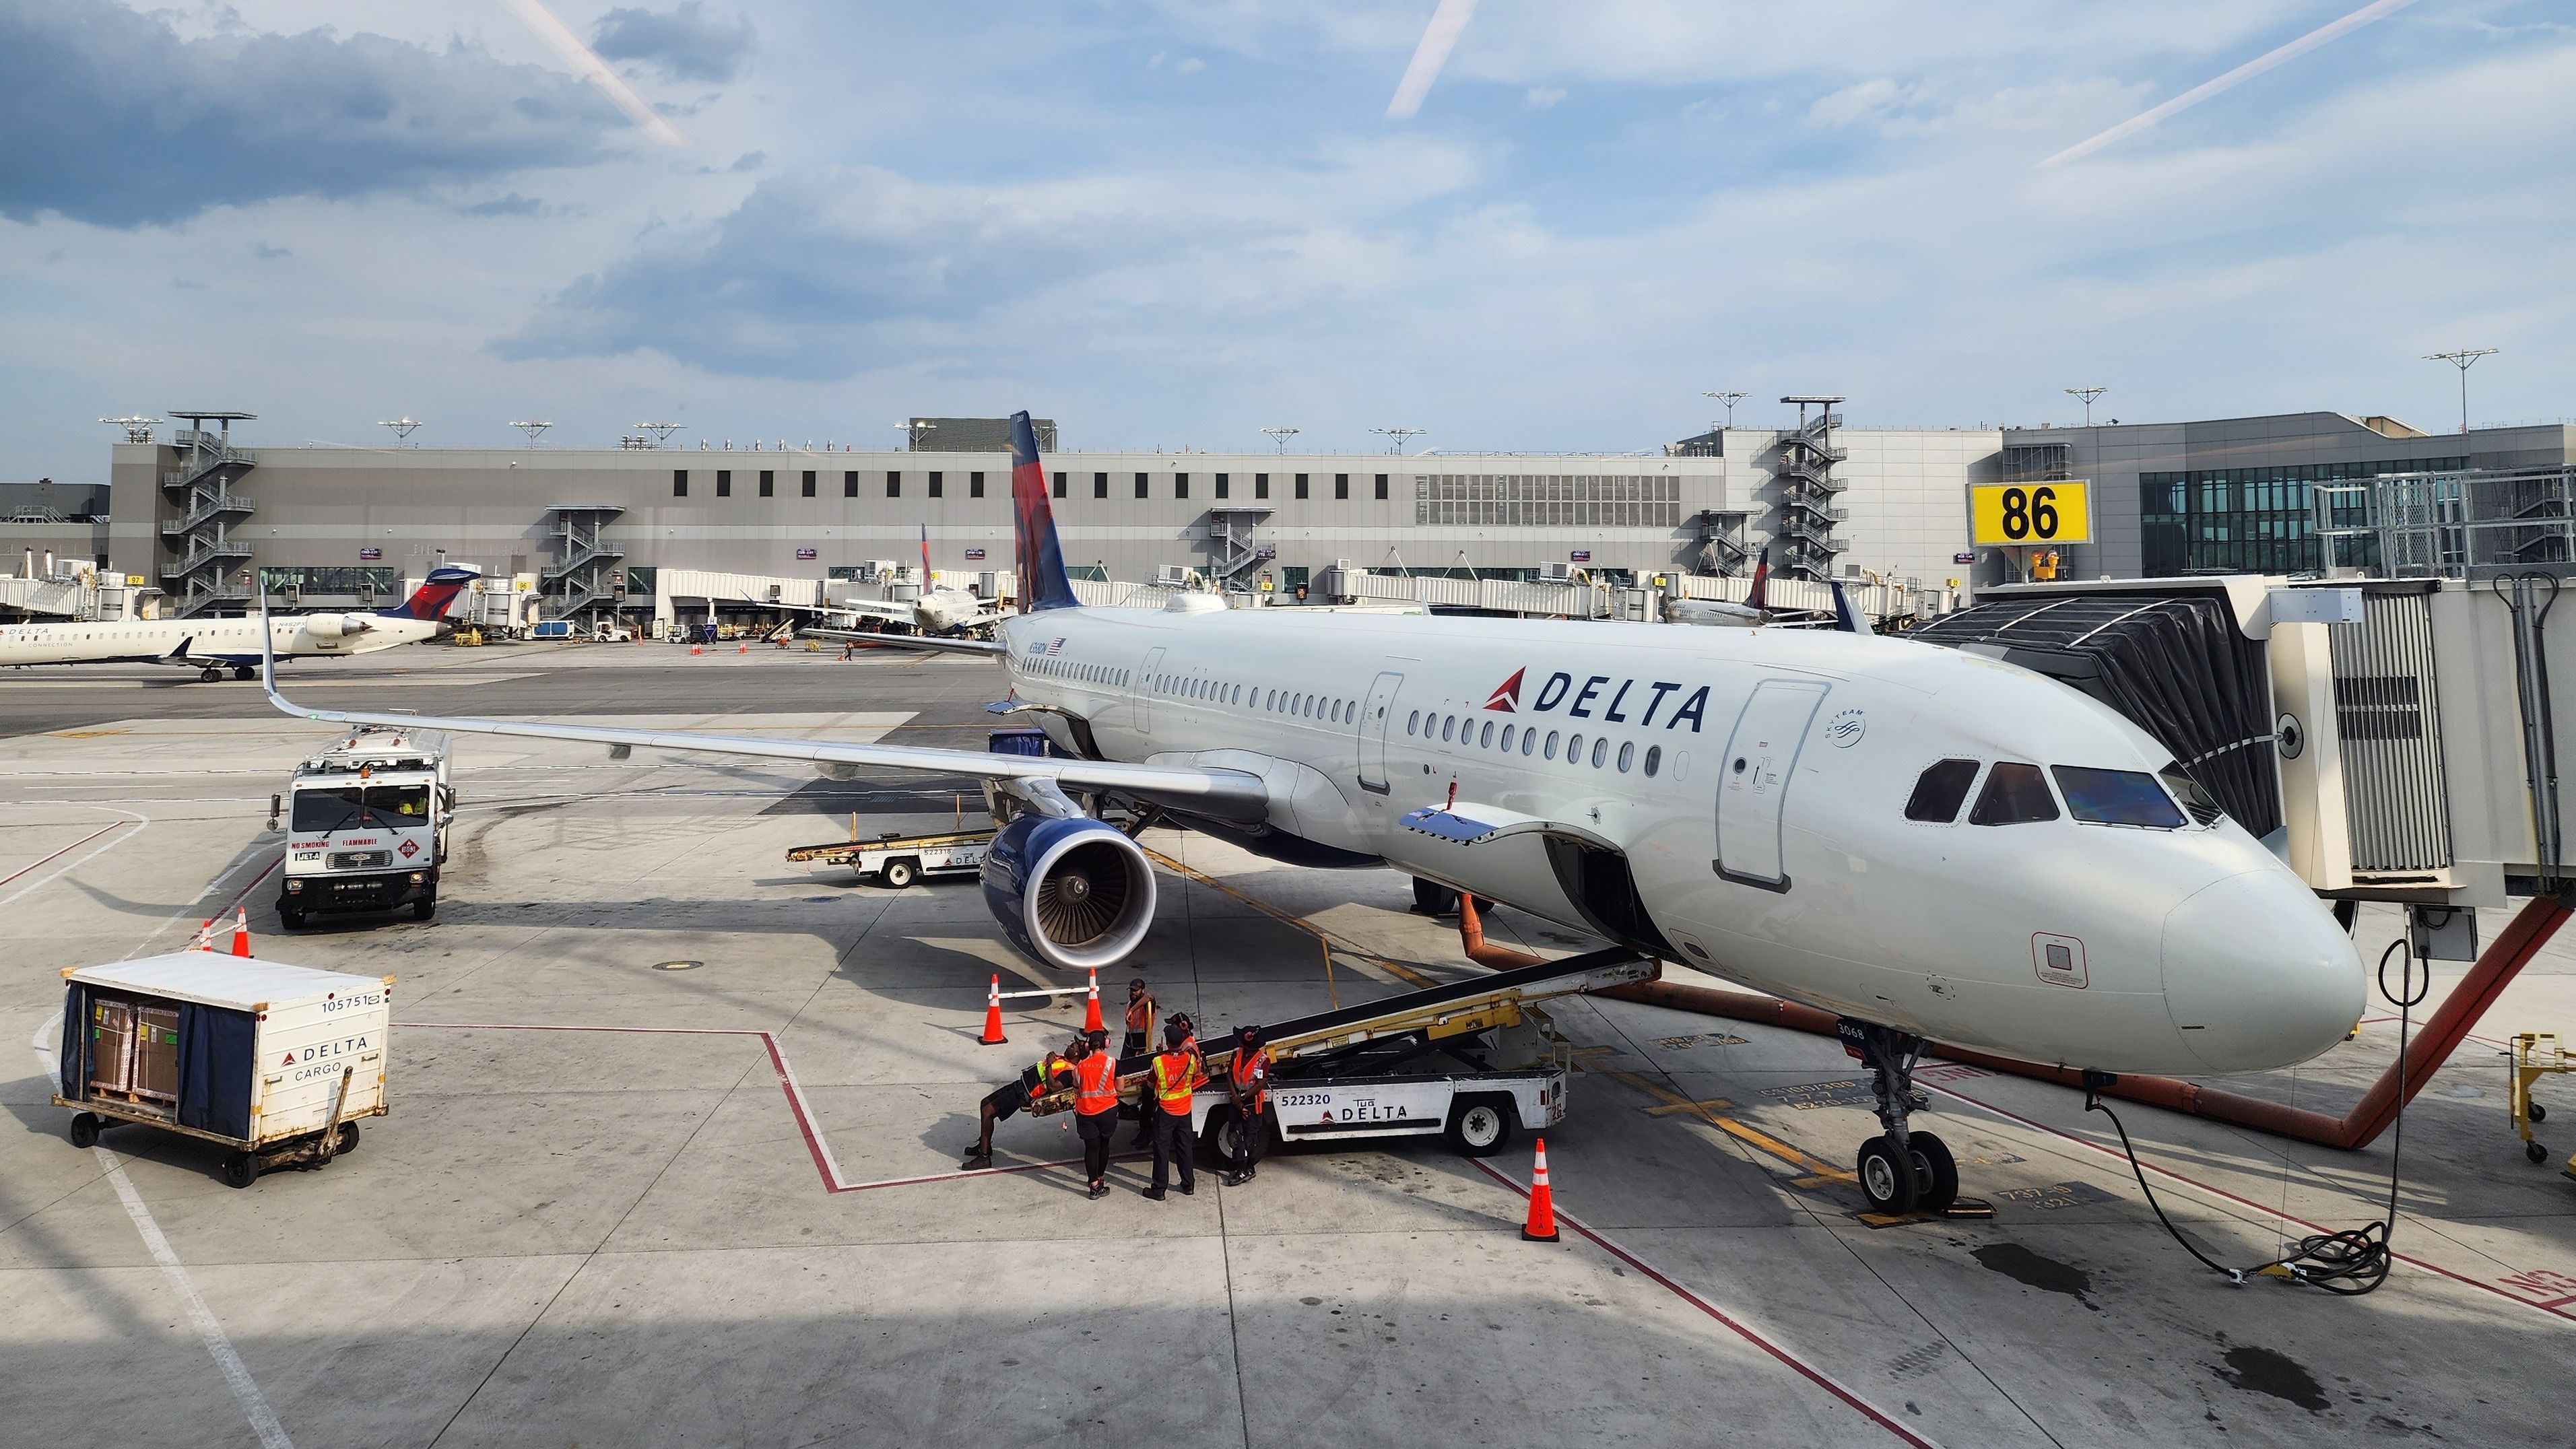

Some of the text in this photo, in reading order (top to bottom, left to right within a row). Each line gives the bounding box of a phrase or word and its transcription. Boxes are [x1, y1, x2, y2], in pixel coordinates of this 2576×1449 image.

[2002, 487, 2058, 539] 86
[1533, 672, 1711, 733] DELTA
[1825, 709, 1863, 739] SKYTEAM
[342, 838, 378, 846] FLAMMABLE
[300, 852, 320, 861] JET-A
[322, 995, 367, 1013] 105751
[1837, 1023, 1864, 1040] 3068
[304, 1037, 367, 1061] DELTA
[295, 1062, 341, 1081] CARGO
[1282, 1094, 1331, 1106] 522320
[1353, 1098, 1375, 1107] TUG
[1342, 1106, 1407, 1121] DELTA
